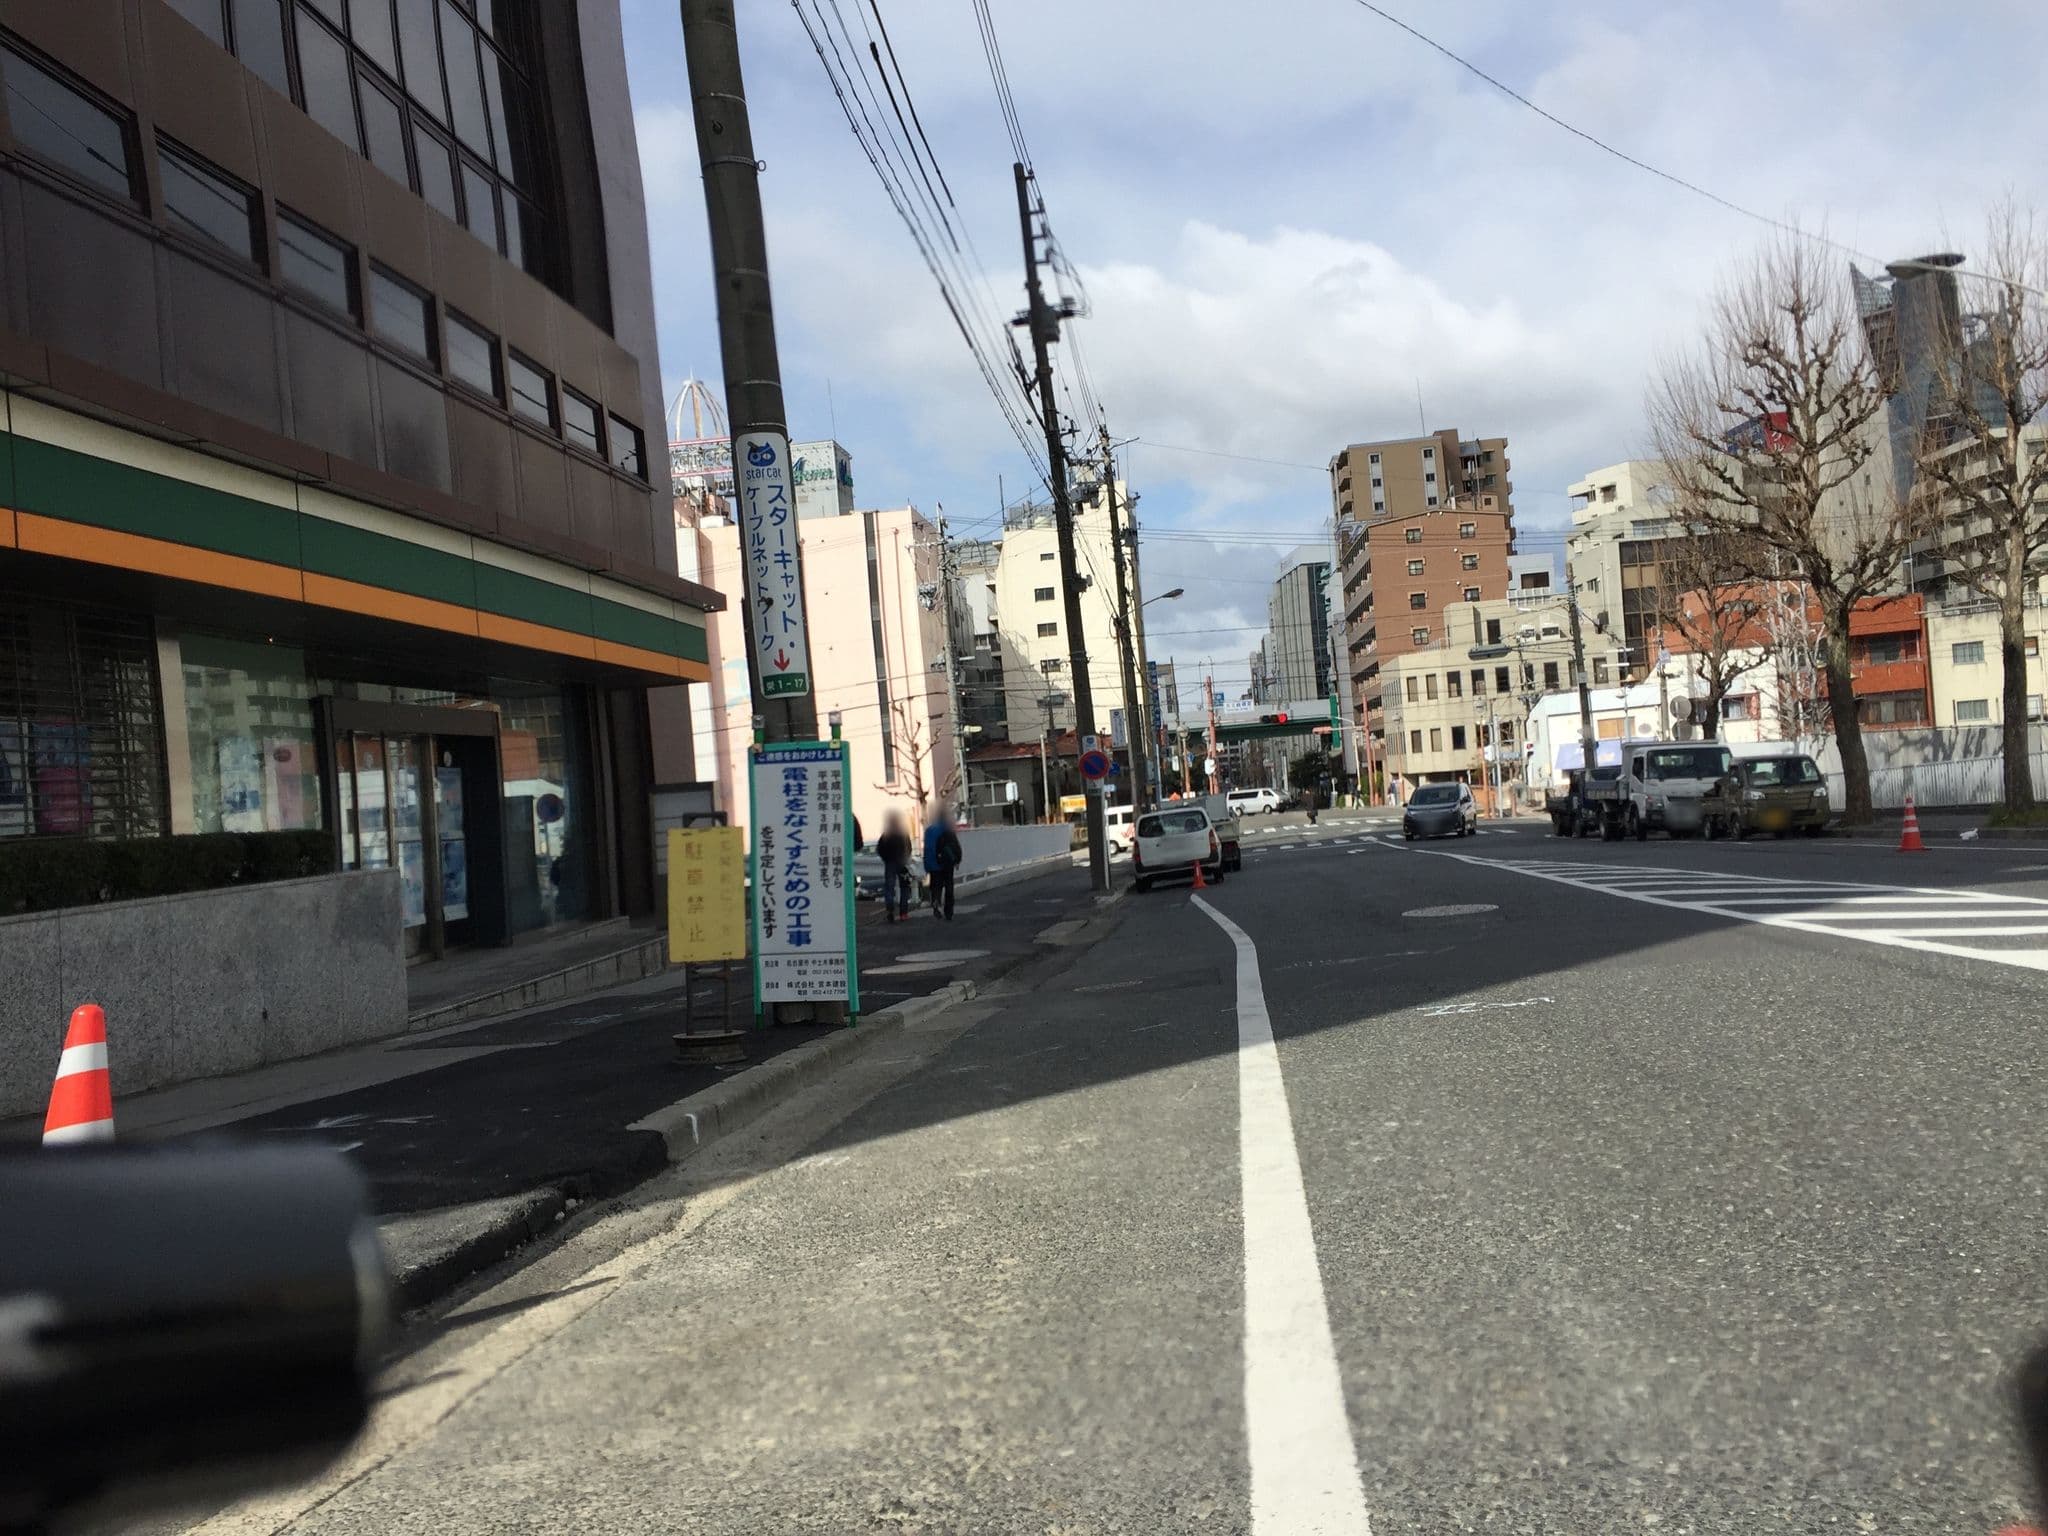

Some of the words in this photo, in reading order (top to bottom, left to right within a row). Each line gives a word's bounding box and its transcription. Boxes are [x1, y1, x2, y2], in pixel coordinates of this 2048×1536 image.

[760, 826, 778, 938] を予定しています
[782, 767, 812, 947] 電柱をなくすための工事
